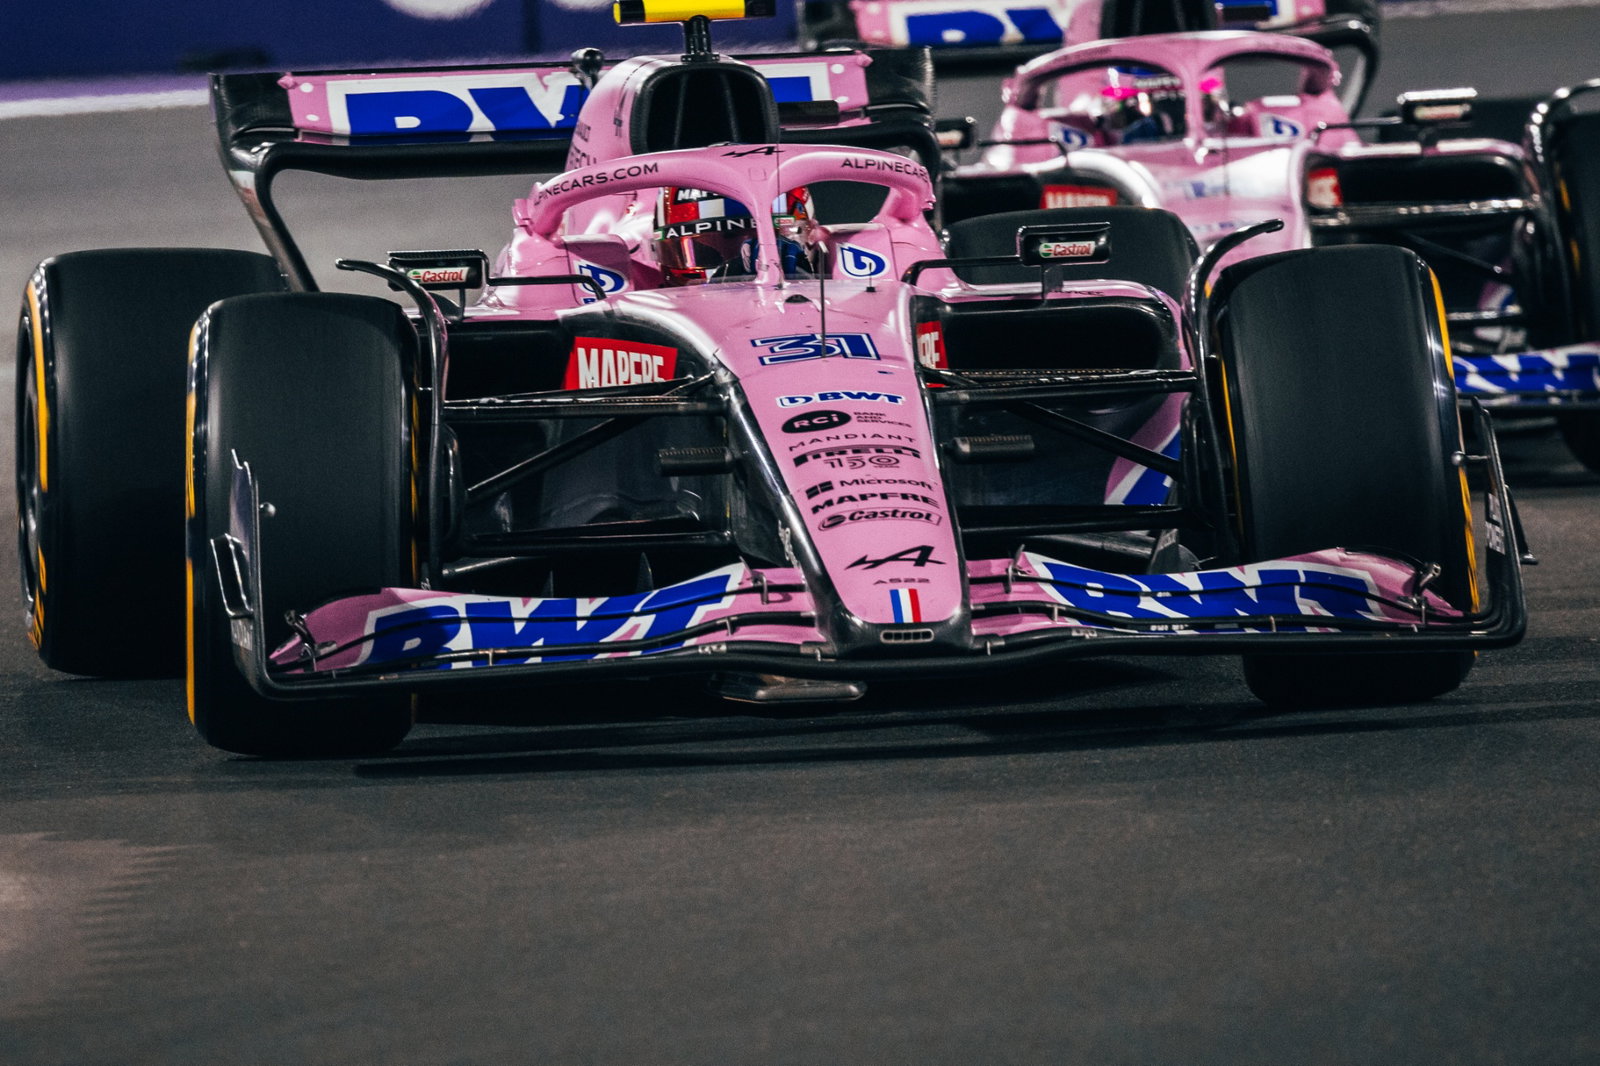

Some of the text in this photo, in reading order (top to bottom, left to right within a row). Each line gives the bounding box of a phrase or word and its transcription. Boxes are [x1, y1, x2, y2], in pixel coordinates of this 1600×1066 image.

[1053, 243, 1092, 256] Castrol
[422, 270, 464, 283] Castrol
[751, 332, 881, 366] 31
[818, 391, 904, 404] BWT
[789, 433, 917, 452] MANDIANT
[793, 444, 921, 468] PIRELLI
[840, 478, 934, 491] Microsoft
[811, 492, 940, 515] MAPFRE
[848, 508, 934, 523] Castrol
